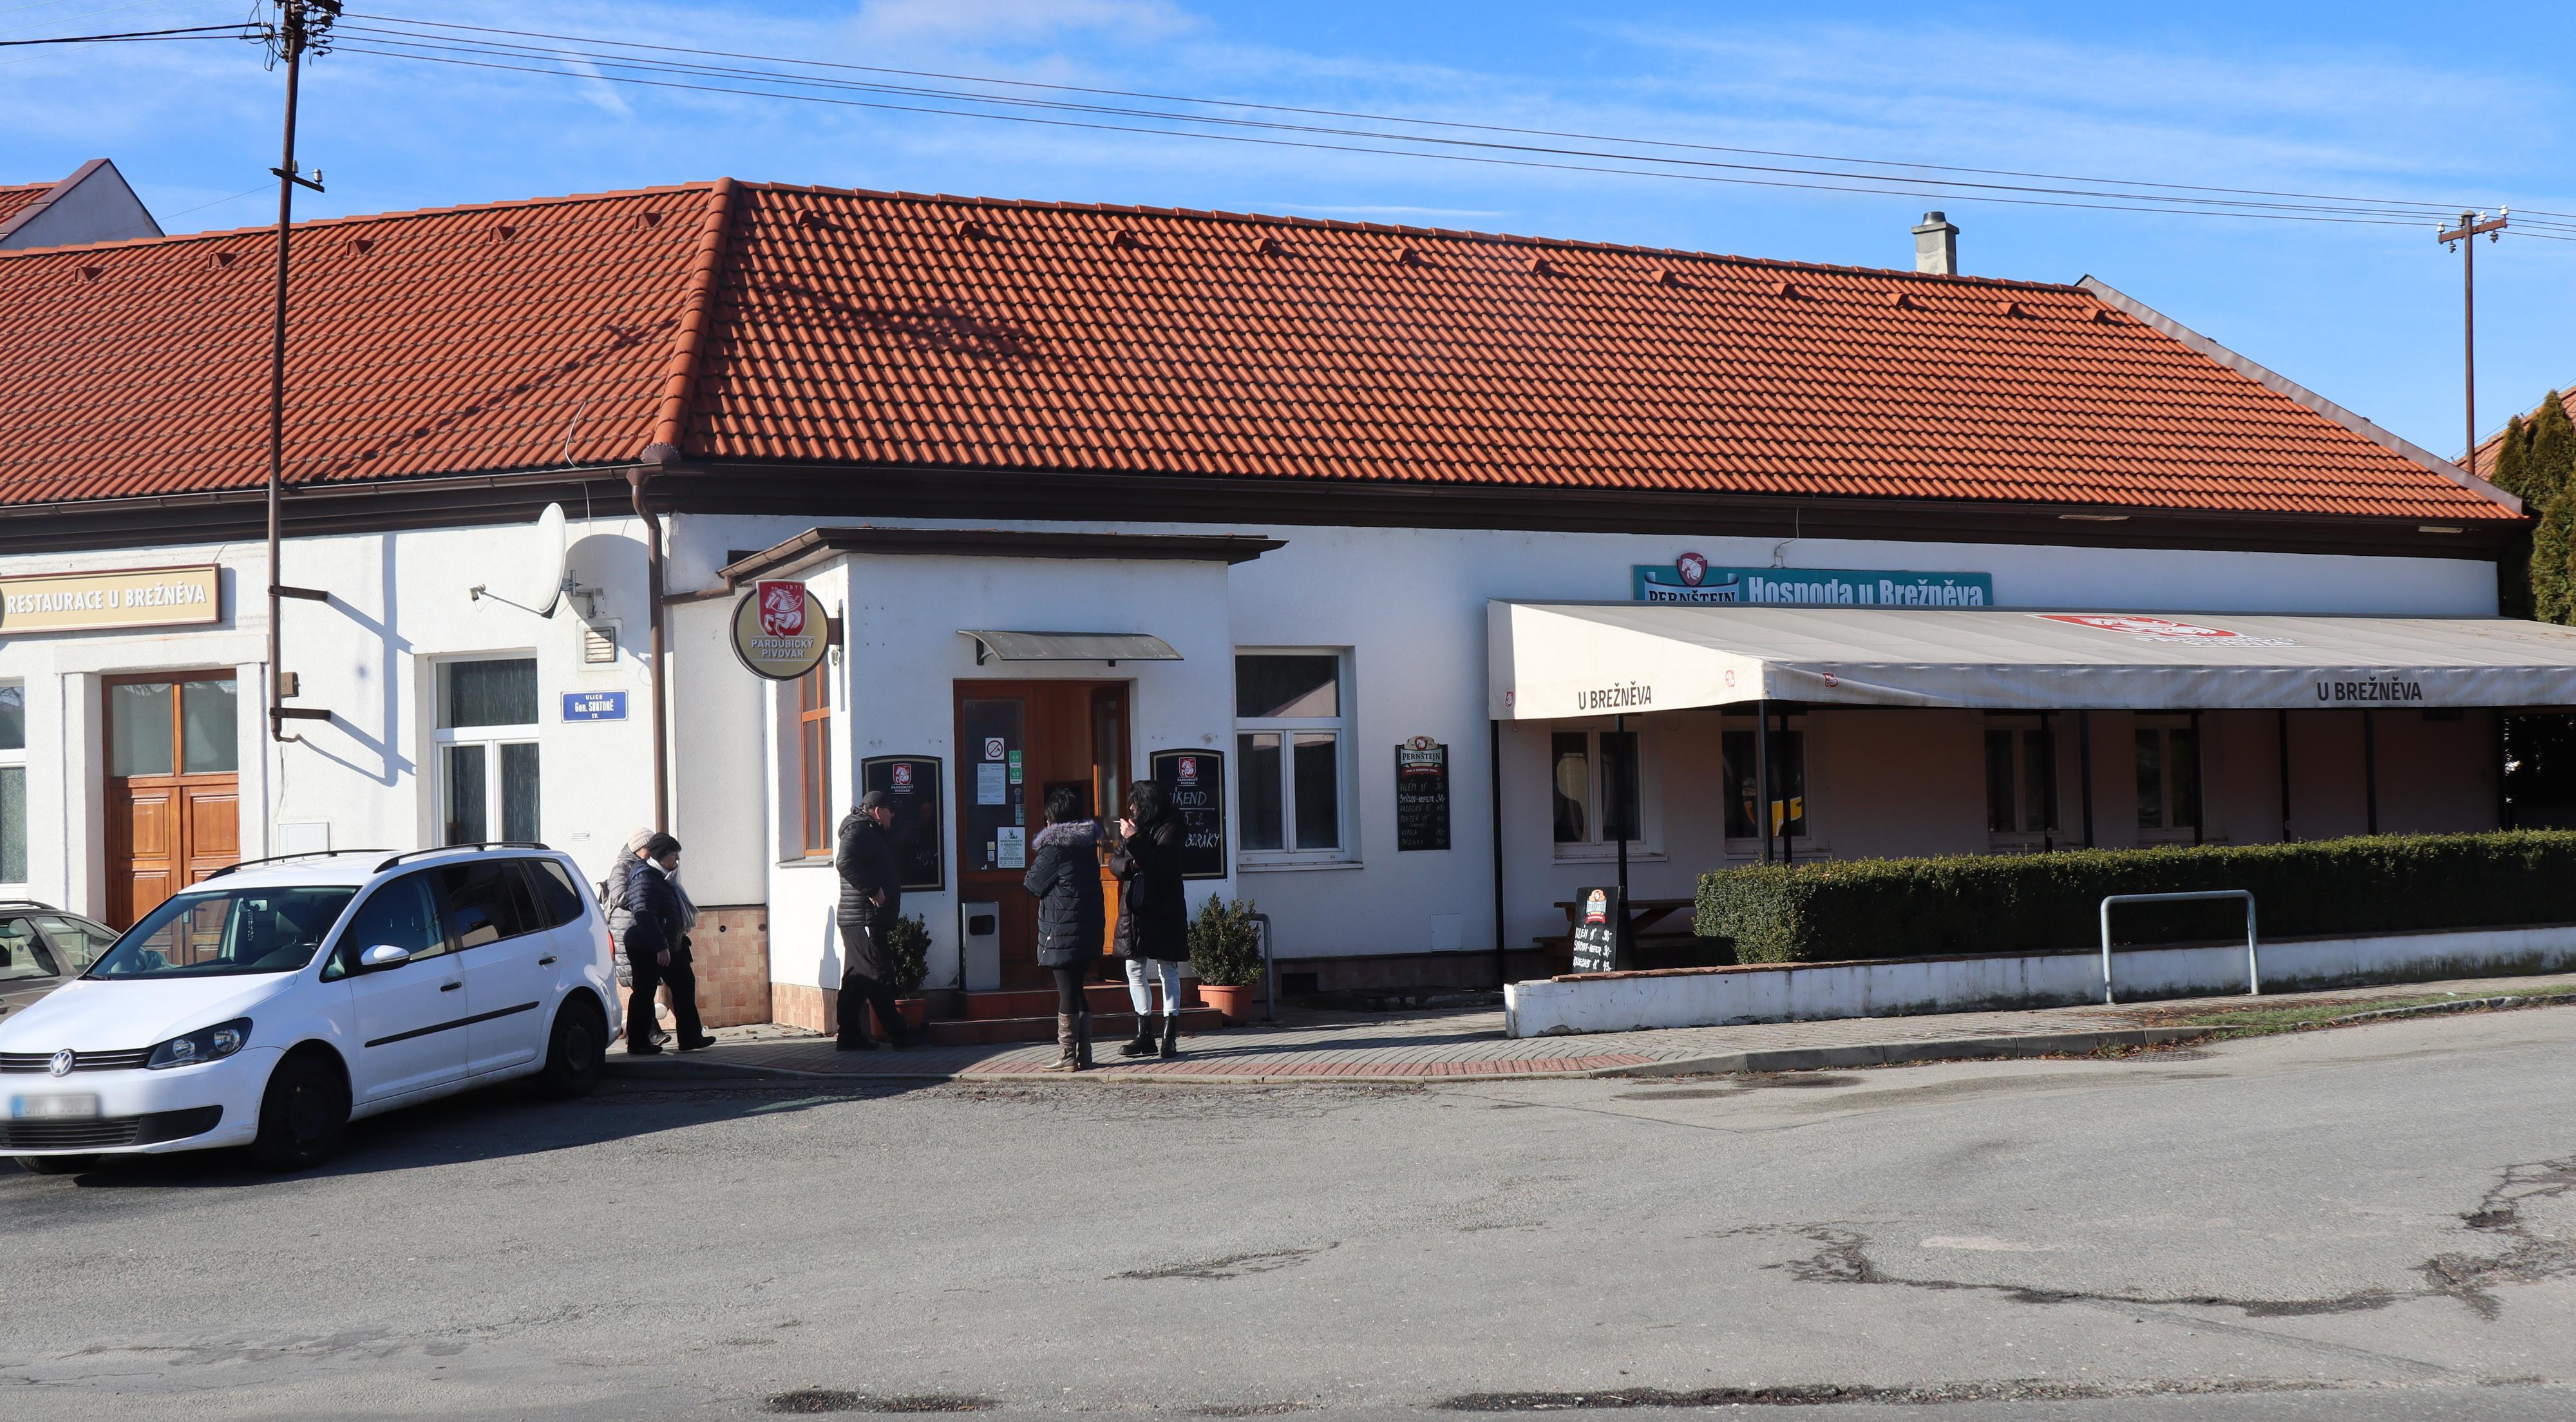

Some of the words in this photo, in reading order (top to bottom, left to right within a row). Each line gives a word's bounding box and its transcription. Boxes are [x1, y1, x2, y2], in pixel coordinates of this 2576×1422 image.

[7, 589, 104, 614] RESTAURACE
[108, 589, 121, 609] U
[125, 580, 207, 607] BREŽNĚVA
[1858, 584, 1873, 604] u
[1879, 579, 1984, 606] Brežněva
[752, 638, 814, 649] PARDUBICKÝ
[762, 649, 804, 658] PIVOVAR
[1578, 692, 1587, 710] U
[1591, 681, 1651, 709] BREŽNĚVA
[2317, 682, 2329, 701] U
[2334, 677, 2422, 701] BREŽNĚVA
[574, 702, 588, 712] Gen.
[589, 699, 614, 712] SVATONĚ
[1402, 752, 1441, 761] PERNŠTEJN
[1169, 786, 1208, 806] ÍKEND
